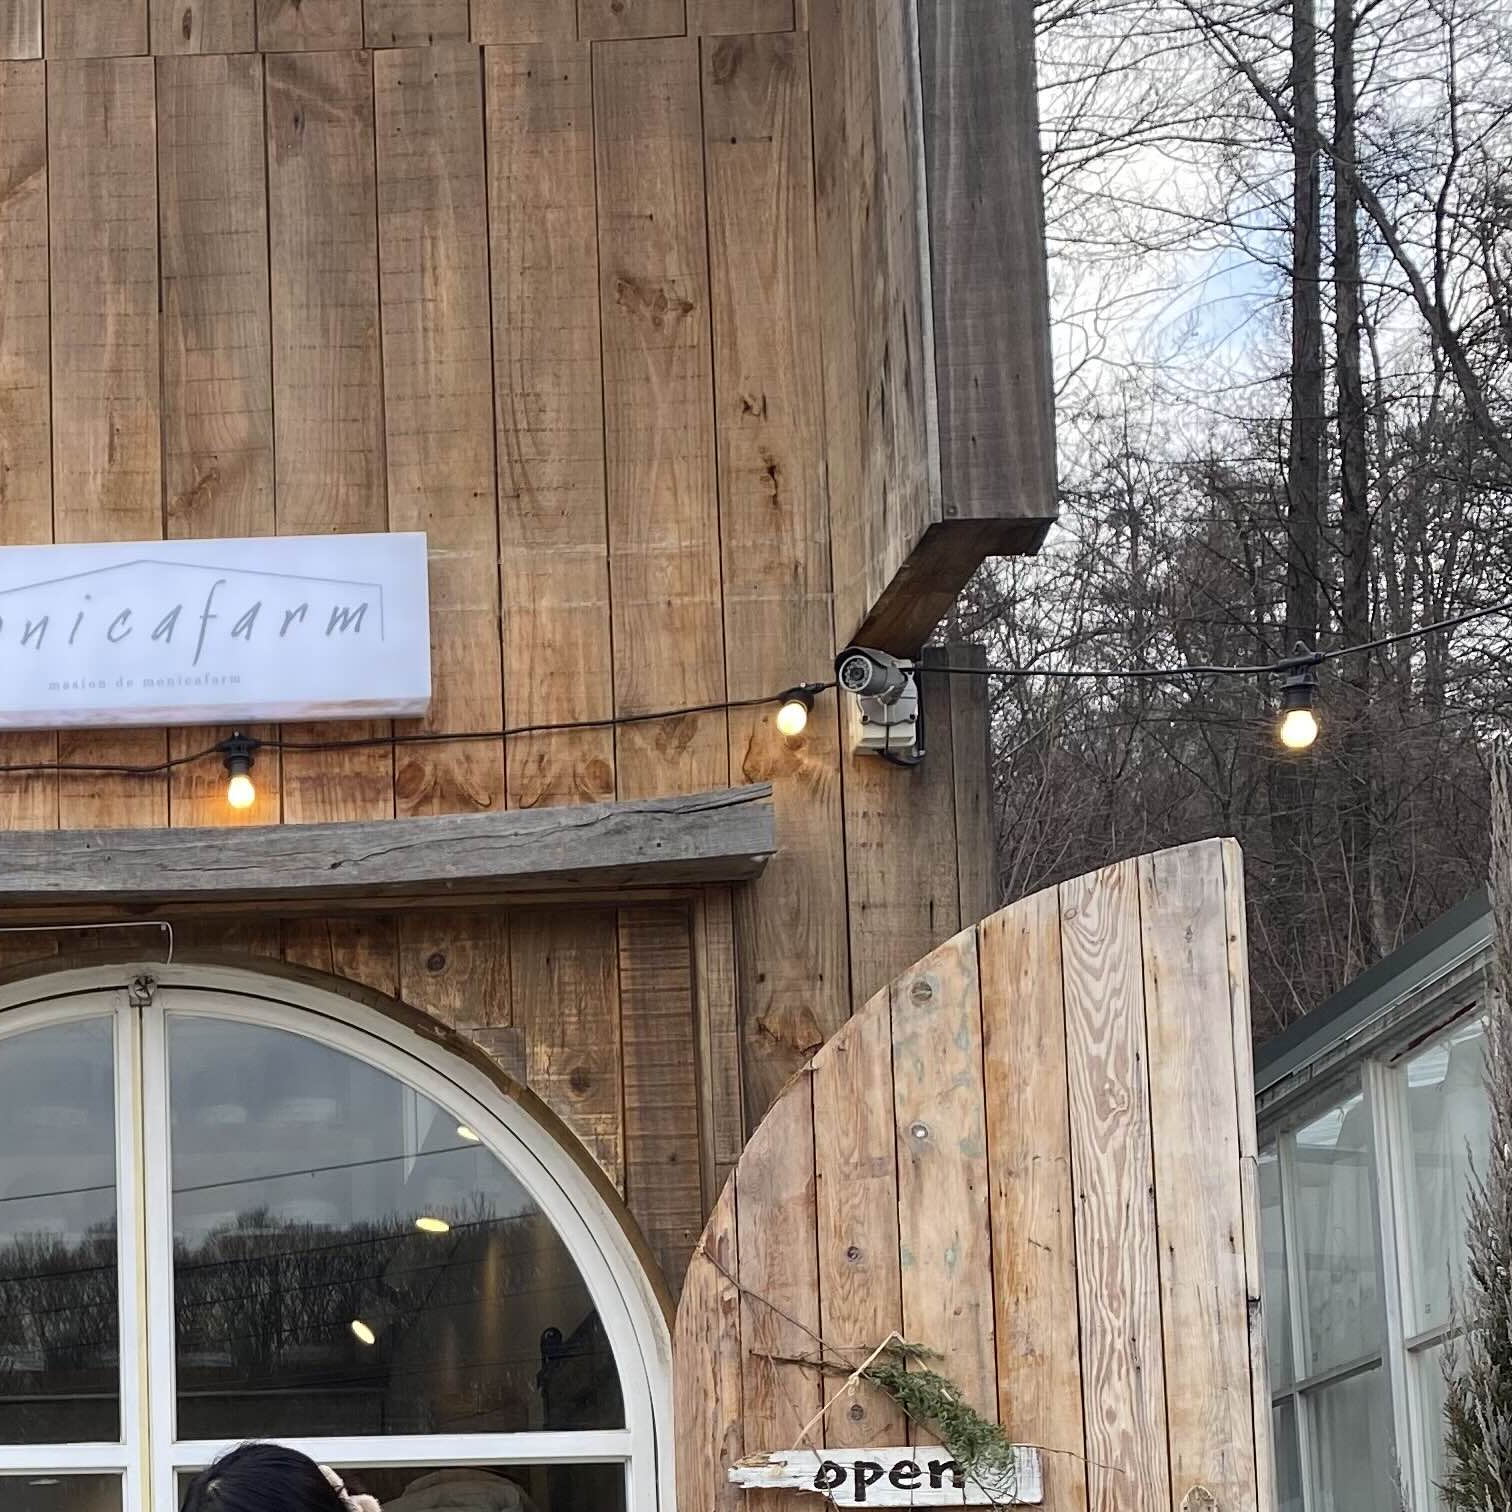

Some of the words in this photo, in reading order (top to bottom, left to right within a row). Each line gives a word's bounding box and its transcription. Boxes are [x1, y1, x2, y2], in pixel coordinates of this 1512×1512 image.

[115, 675, 134, 689] de
[142, 672, 241, 688] monicafarm
[813, 1459, 966, 1502] open
